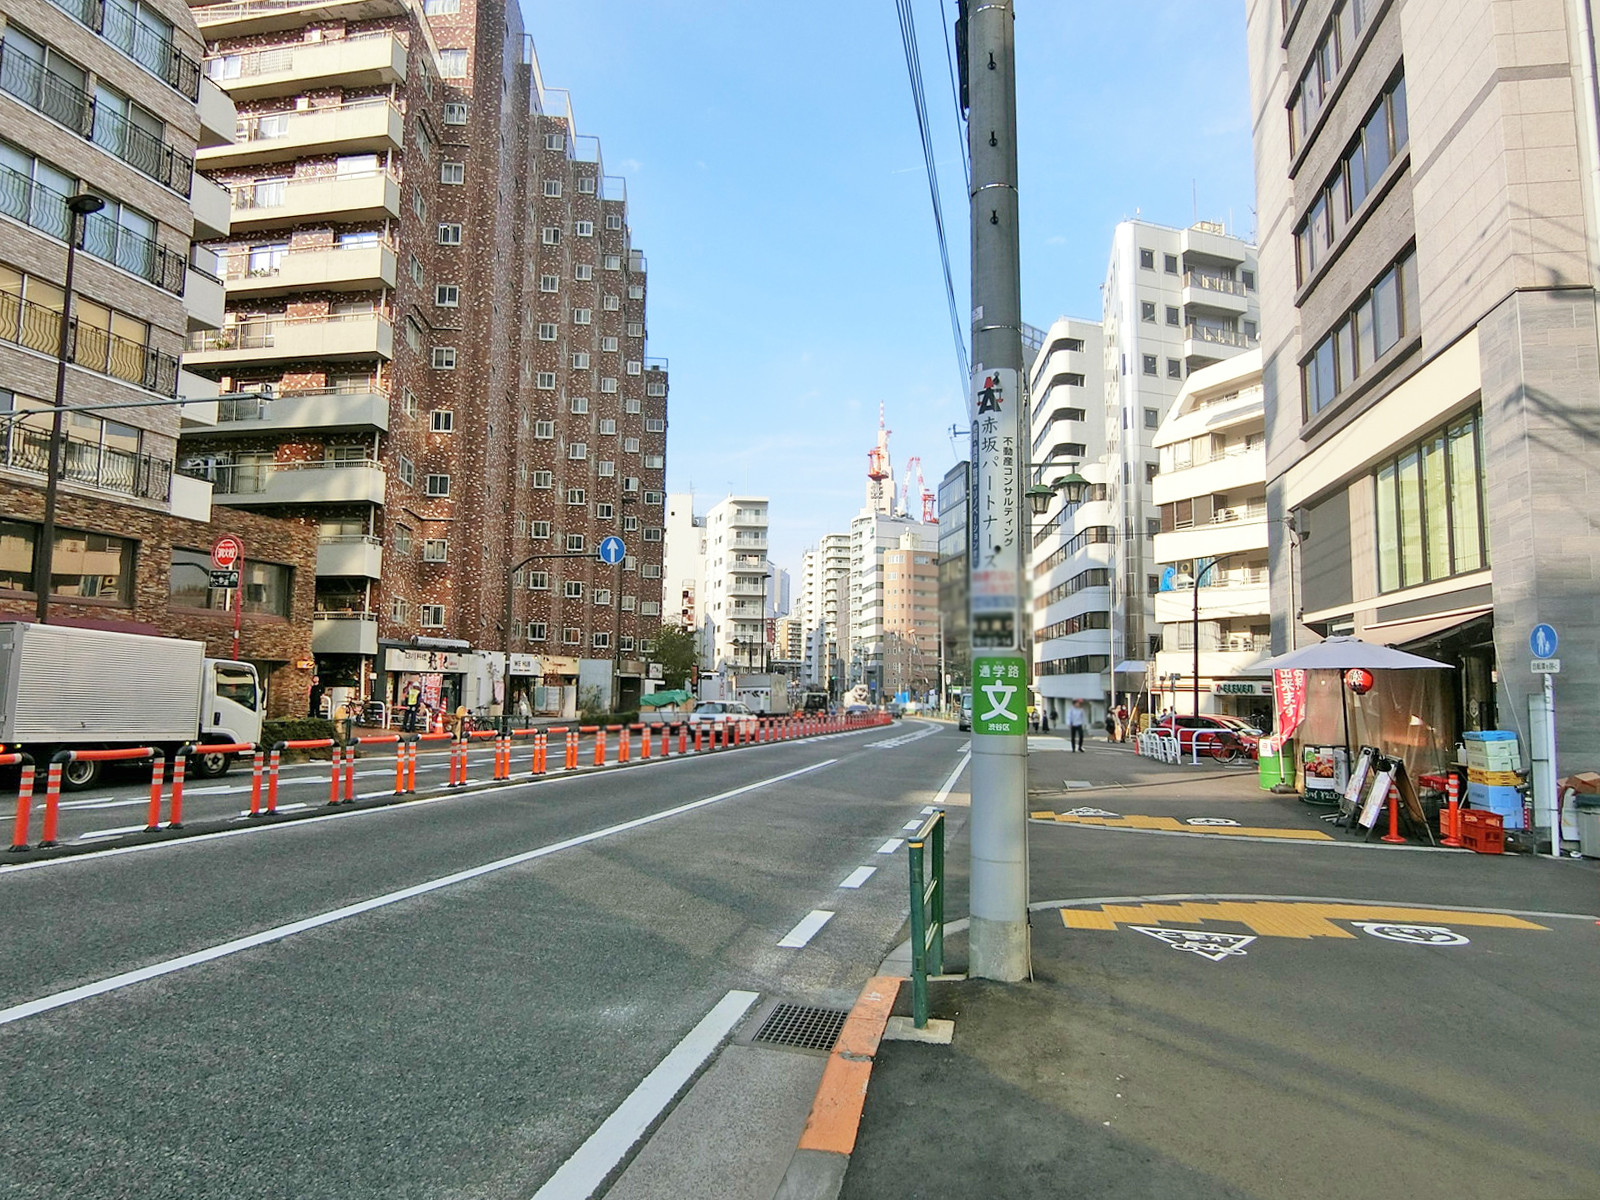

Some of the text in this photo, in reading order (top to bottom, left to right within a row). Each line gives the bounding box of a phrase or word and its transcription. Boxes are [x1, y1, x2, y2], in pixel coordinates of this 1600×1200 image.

[1002, 436, 1014, 547] 不動産コンサルティング
[980, 665, 1019, 678] 通学路
[980, 679, 1018, 721] 文
[987, 723, 1010, 731] 渋谷区
